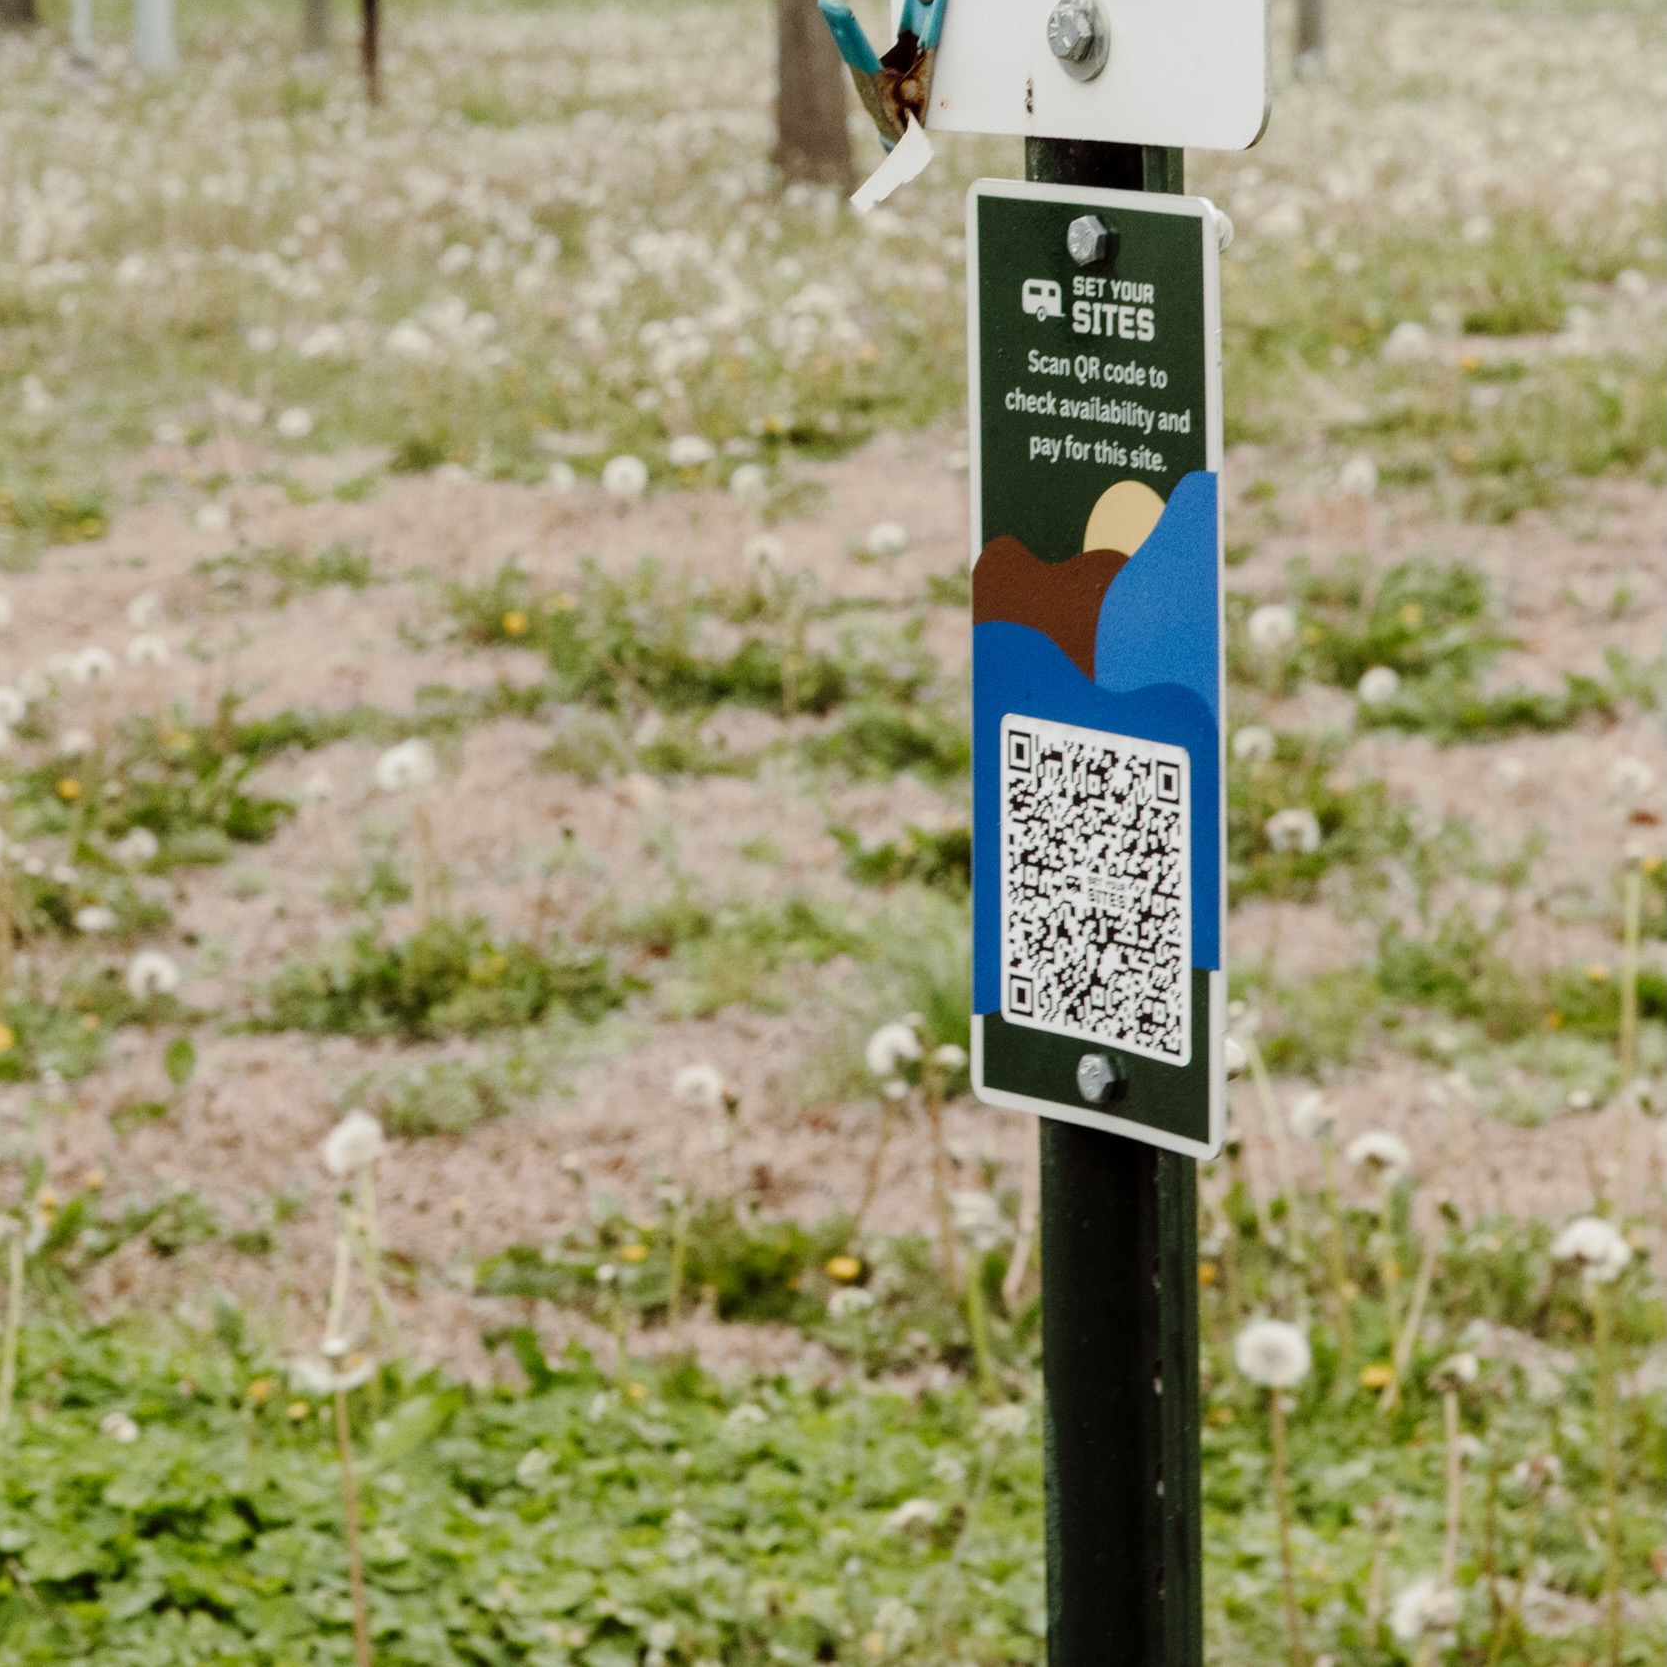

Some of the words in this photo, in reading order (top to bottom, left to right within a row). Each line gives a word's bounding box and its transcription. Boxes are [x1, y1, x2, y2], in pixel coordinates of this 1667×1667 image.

[1072, 275, 1107, 298] SET
[1110, 279, 1155, 304] YOUR
[1071, 300, 1156, 342] SITES
[1028, 349, 1070, 377] Scan
[1074, 354, 1100, 384] QR
[1103, 361, 1146, 387] code
[1148, 366, 1168, 389] to
[1005, 387, 1057, 416] check
[1059, 396, 1155, 435] availability
[1157, 409, 1191, 434] and
[1029, 435, 1062, 463] pay
[1064, 434, 1092, 461] for
[1094, 439, 1127, 467] this
[1130, 444, 1168, 473] site.
